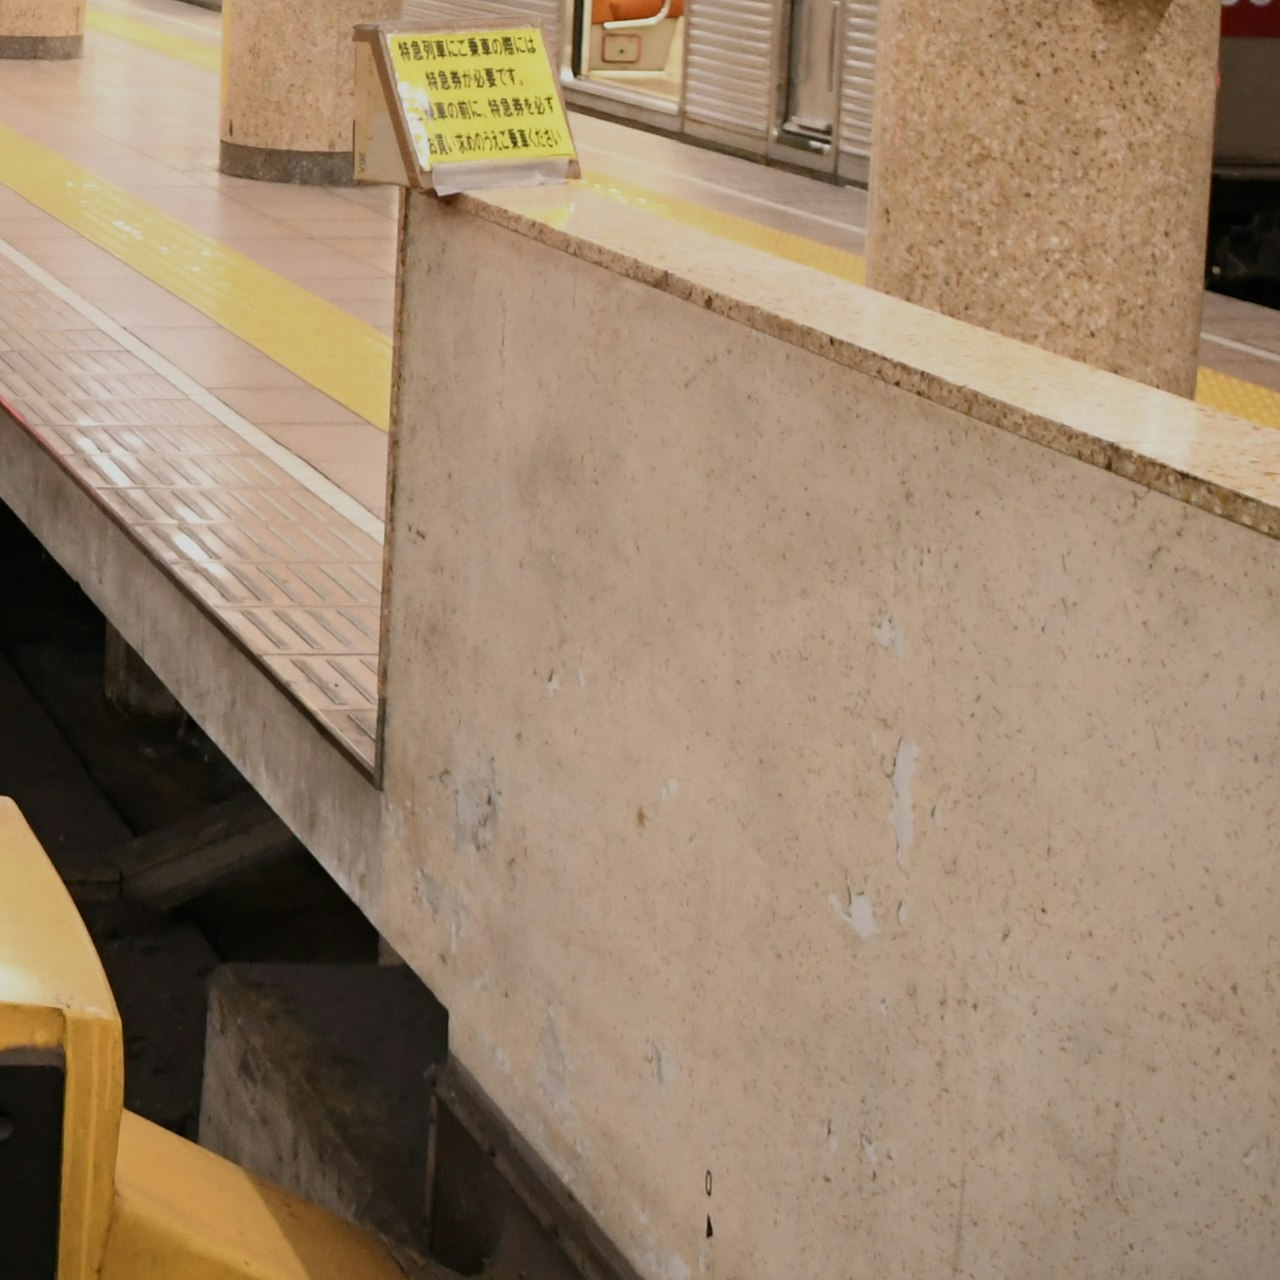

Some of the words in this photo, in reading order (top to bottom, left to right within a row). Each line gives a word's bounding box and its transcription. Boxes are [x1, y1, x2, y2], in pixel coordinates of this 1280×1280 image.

[398, 36, 536, 61] 特急列車にご乗車の際には
[425, 67, 524, 91] 特急券が必要です。
